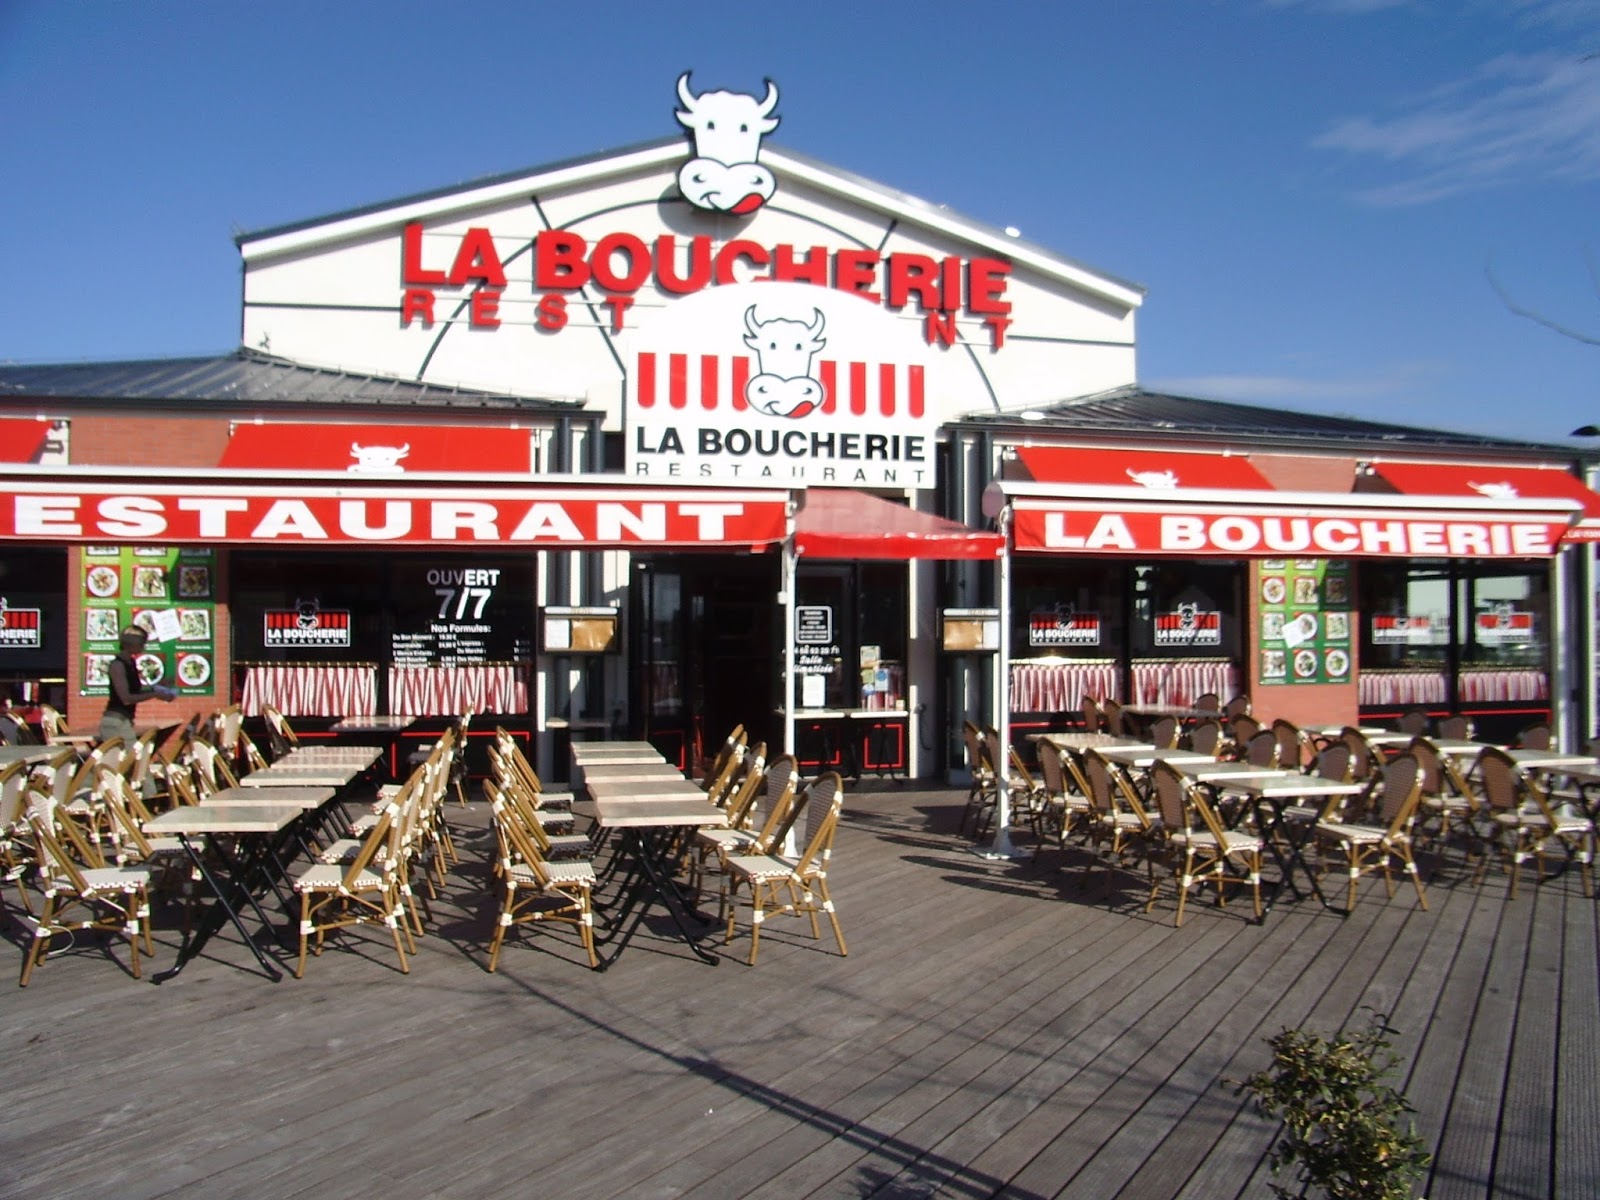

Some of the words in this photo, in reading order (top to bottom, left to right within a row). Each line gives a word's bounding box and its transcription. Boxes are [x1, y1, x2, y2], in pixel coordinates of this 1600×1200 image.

[403, 222, 508, 287] LA
[536, 230, 1013, 314] BOUCHERIE
[403, 288, 1013, 350] RESTNT
[636, 426, 685, 455] LA
[697, 427, 926, 462] BOUCHERIE
[636, 462, 926, 484] RESTAURANT
[14, 495, 745, 542] ESTAURANT
[1045, 512, 1138, 549] LA
[1161, 515, 1552, 554] BOUCHERIE
[426, 569, 501, 586] OUVERT
[435, 587, 492, 620] 7/7
[268, 629, 282, 639] LA
[283, 629, 348, 639] BOUCHERIE
[431, 623, 448, 633] Nos
[1032, 628, 1044, 638] LA
[1045, 629, 1097, 638] BOUCHERIE
[1157, 629, 1168, 638] LA
[1169, 629, 1217, 639] BOUCERIE
